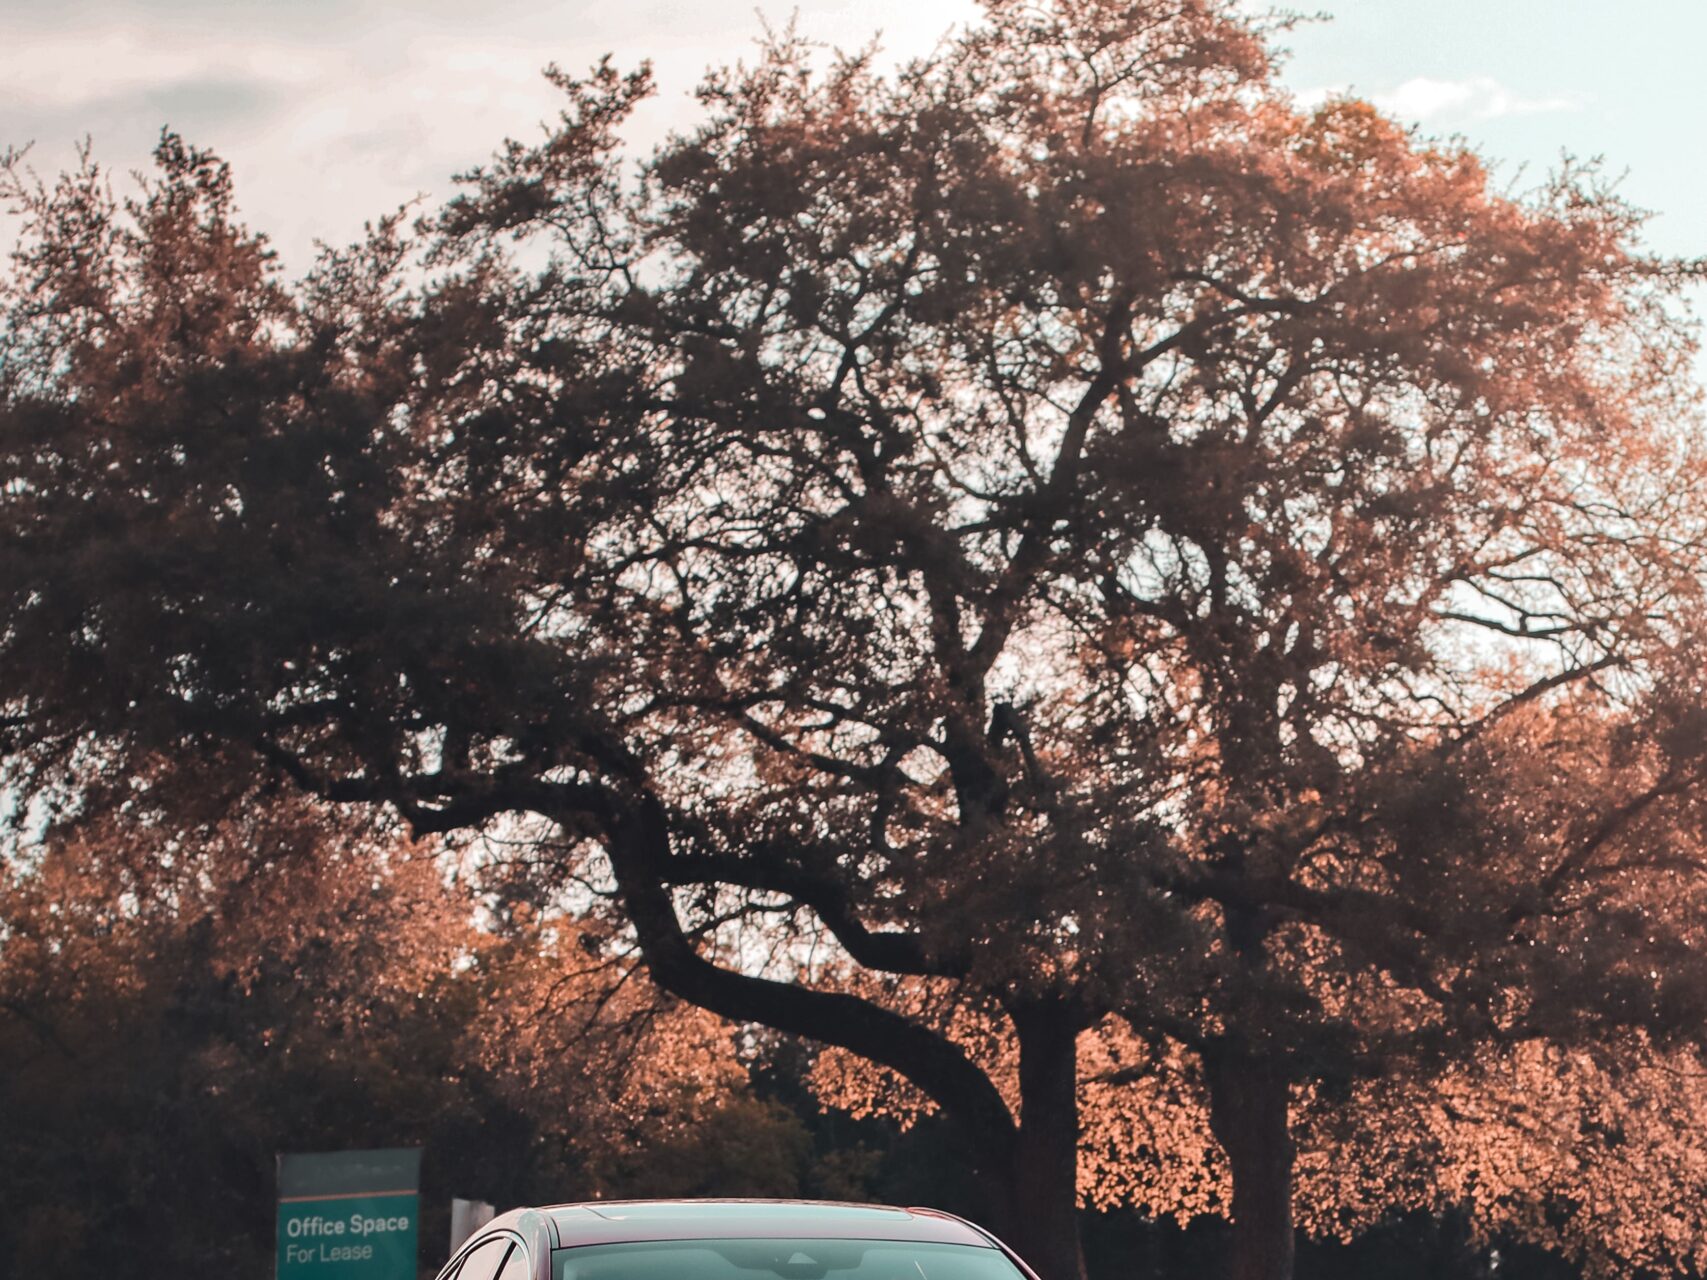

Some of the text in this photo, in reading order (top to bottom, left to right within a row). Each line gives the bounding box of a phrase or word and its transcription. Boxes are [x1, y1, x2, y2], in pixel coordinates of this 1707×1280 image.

[286, 1213, 409, 1238] Office Space
[286, 1243, 373, 1264] For Lease
